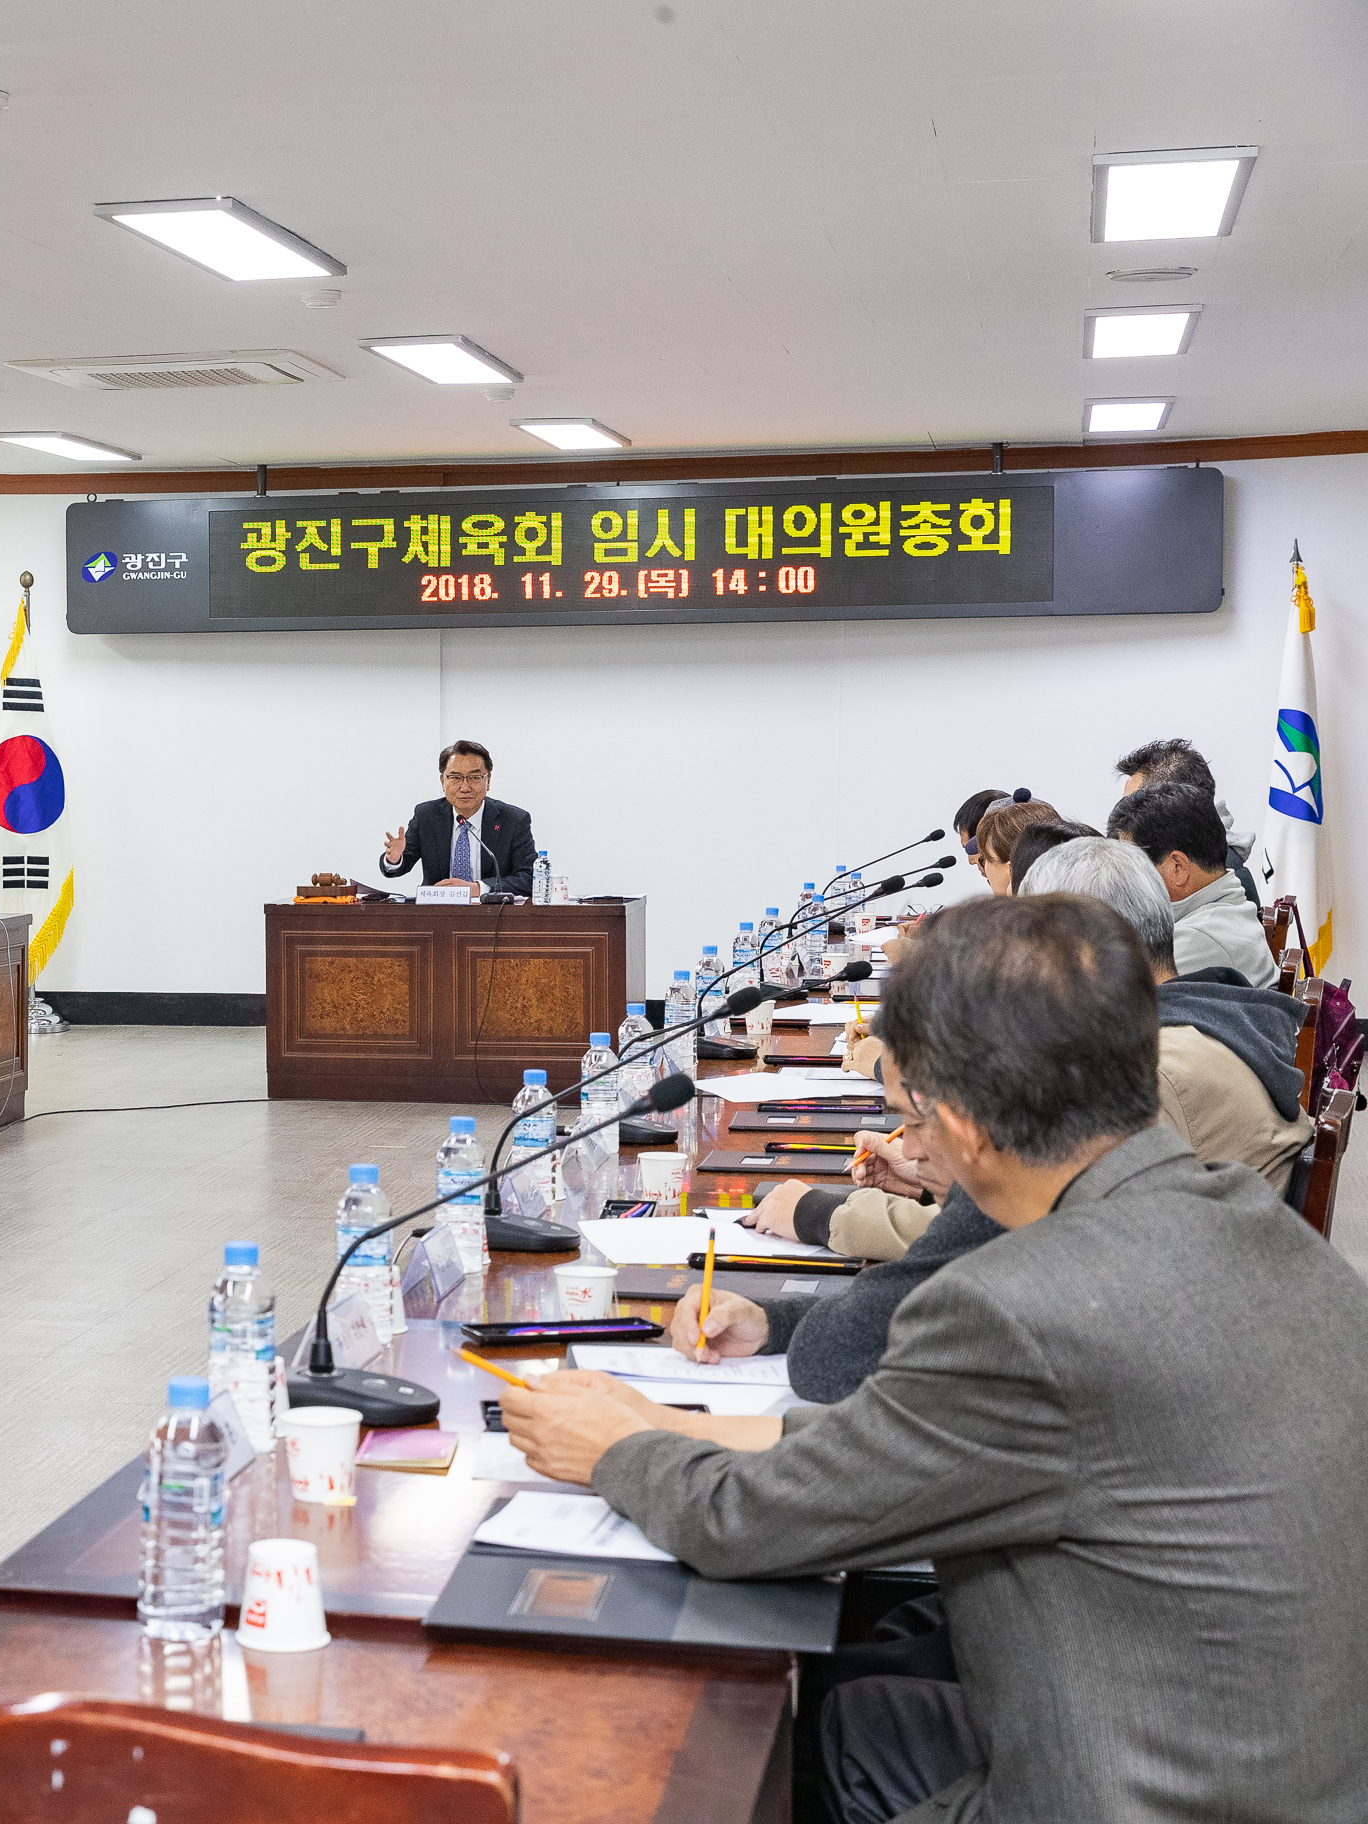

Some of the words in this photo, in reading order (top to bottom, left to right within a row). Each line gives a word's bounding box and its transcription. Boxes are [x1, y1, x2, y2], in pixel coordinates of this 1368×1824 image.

[239, 511, 563, 574] 광진구체육회
[590, 507, 696, 564] 임시
[724, 498, 1013, 559] 대의원총회
[122, 552, 189, 571] 광진구
[122, 570, 187, 580] GWANGJIN-GU
[420, 573, 499, 602] 2018.
[521, 572, 564, 599] 11.
